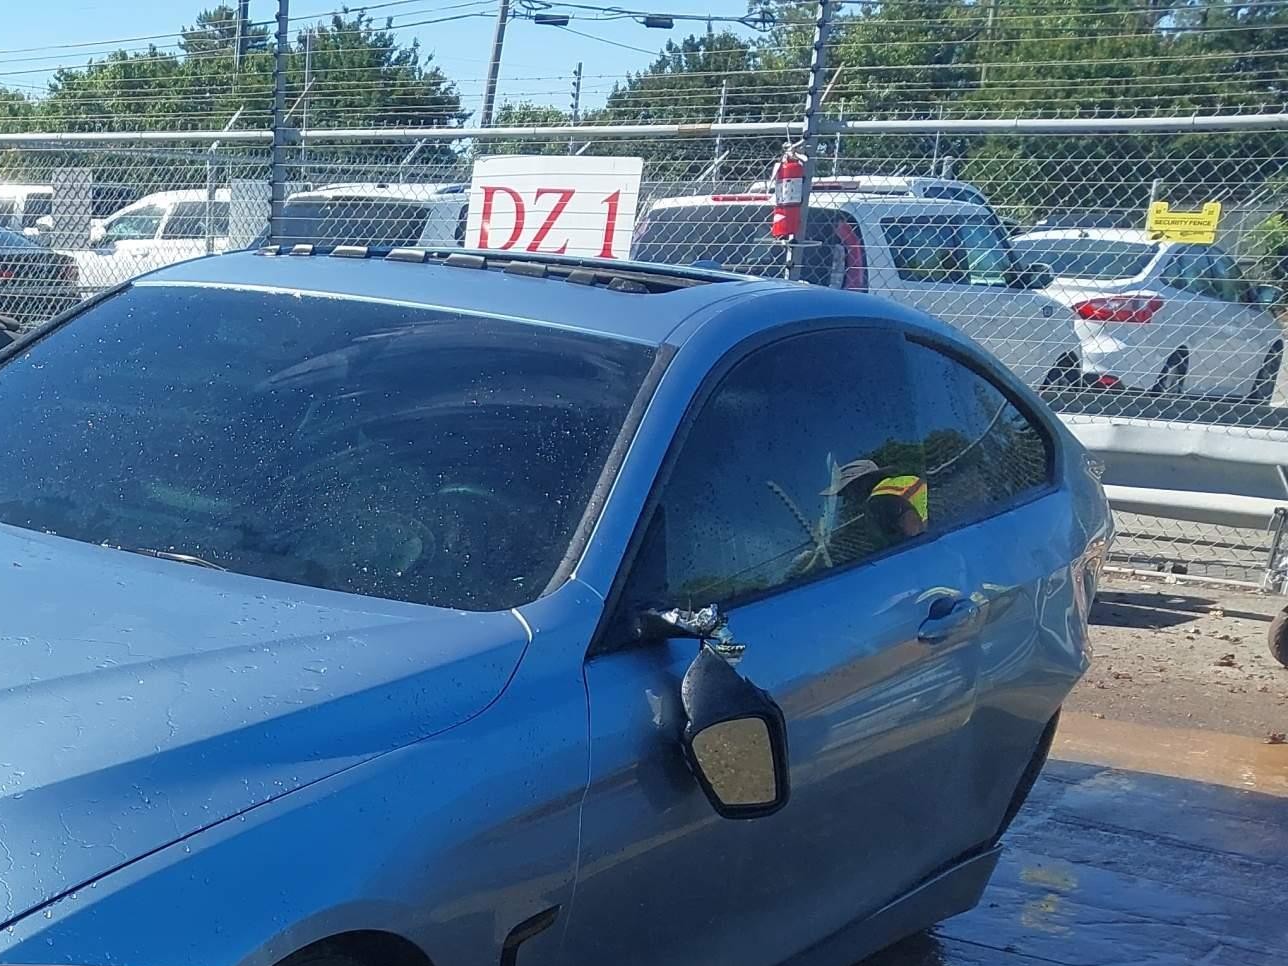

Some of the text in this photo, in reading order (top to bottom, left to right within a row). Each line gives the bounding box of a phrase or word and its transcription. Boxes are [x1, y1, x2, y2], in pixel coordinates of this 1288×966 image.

[478, 186, 620, 259] DZ 1
[1154, 219, 1189, 227] SECURITY
